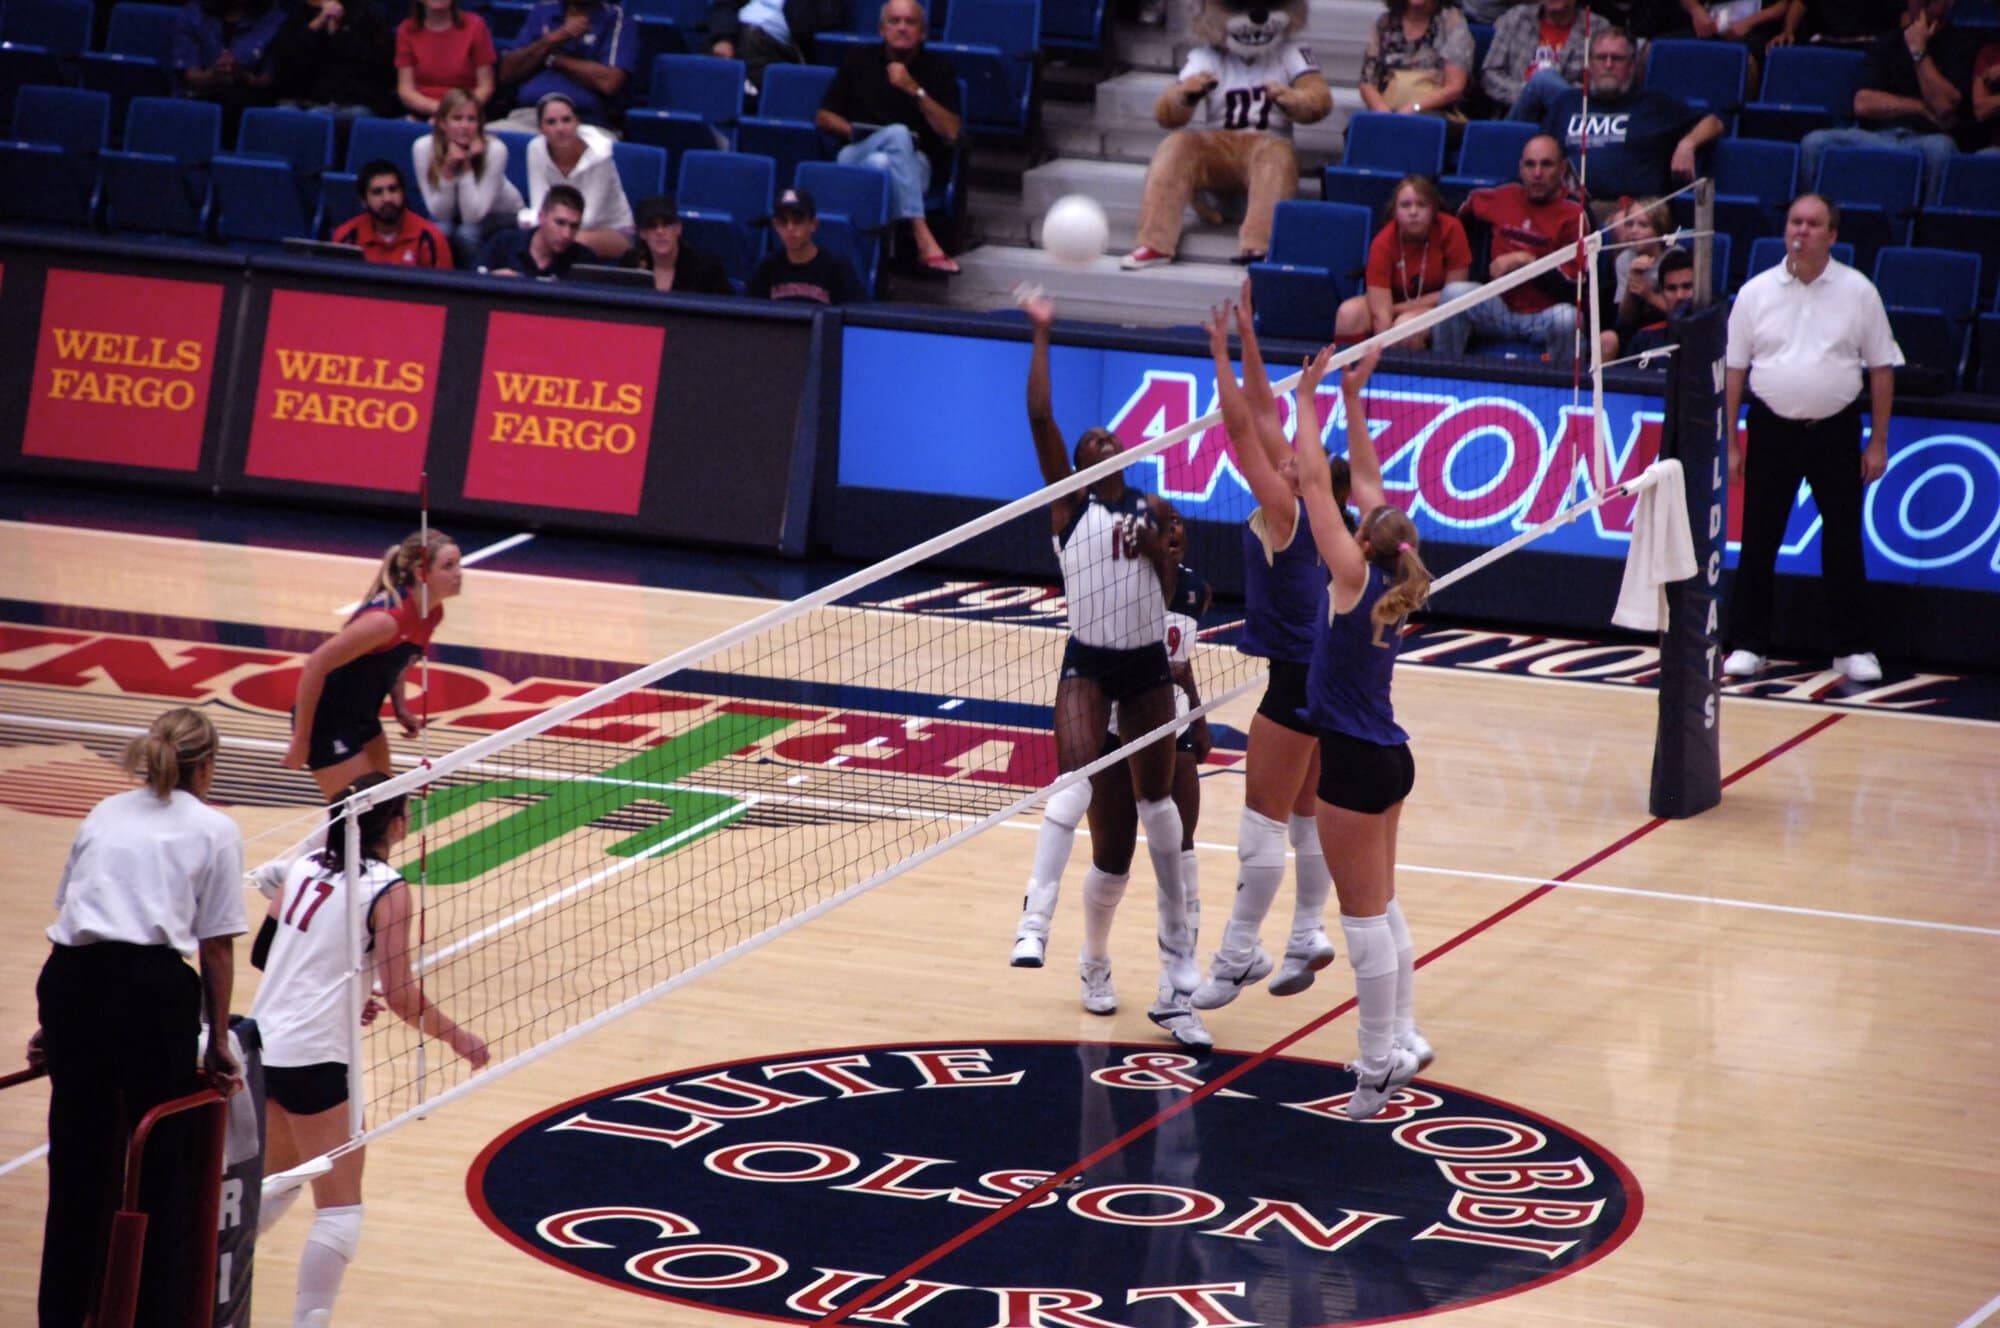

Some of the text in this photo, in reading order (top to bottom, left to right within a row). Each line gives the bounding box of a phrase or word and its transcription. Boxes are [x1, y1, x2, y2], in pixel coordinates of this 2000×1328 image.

[1567, 114, 1630, 136] UMC
[52, 328, 202, 372] WELLS
[275, 348, 425, 393] WELLS
[48, 369, 196, 411] FARGO
[271, 389, 419, 433] FARGO
[494, 371, 642, 415] WELLS
[489, 412, 637, 455] FARGO
[1107, 369, 1748, 553] AZON
[1703, 356, 1726, 730] WILDCATS
[1167, 626, 1181, 657] 9
[284, 877, 334, 933] 17
[545, 1049, 1026, 1149] LUTE
[1279, 1086, 1608, 1260] BOBBI
[704, 1141, 1405, 1252] OLSON
[536, 1206, 1267, 1328] COURT
